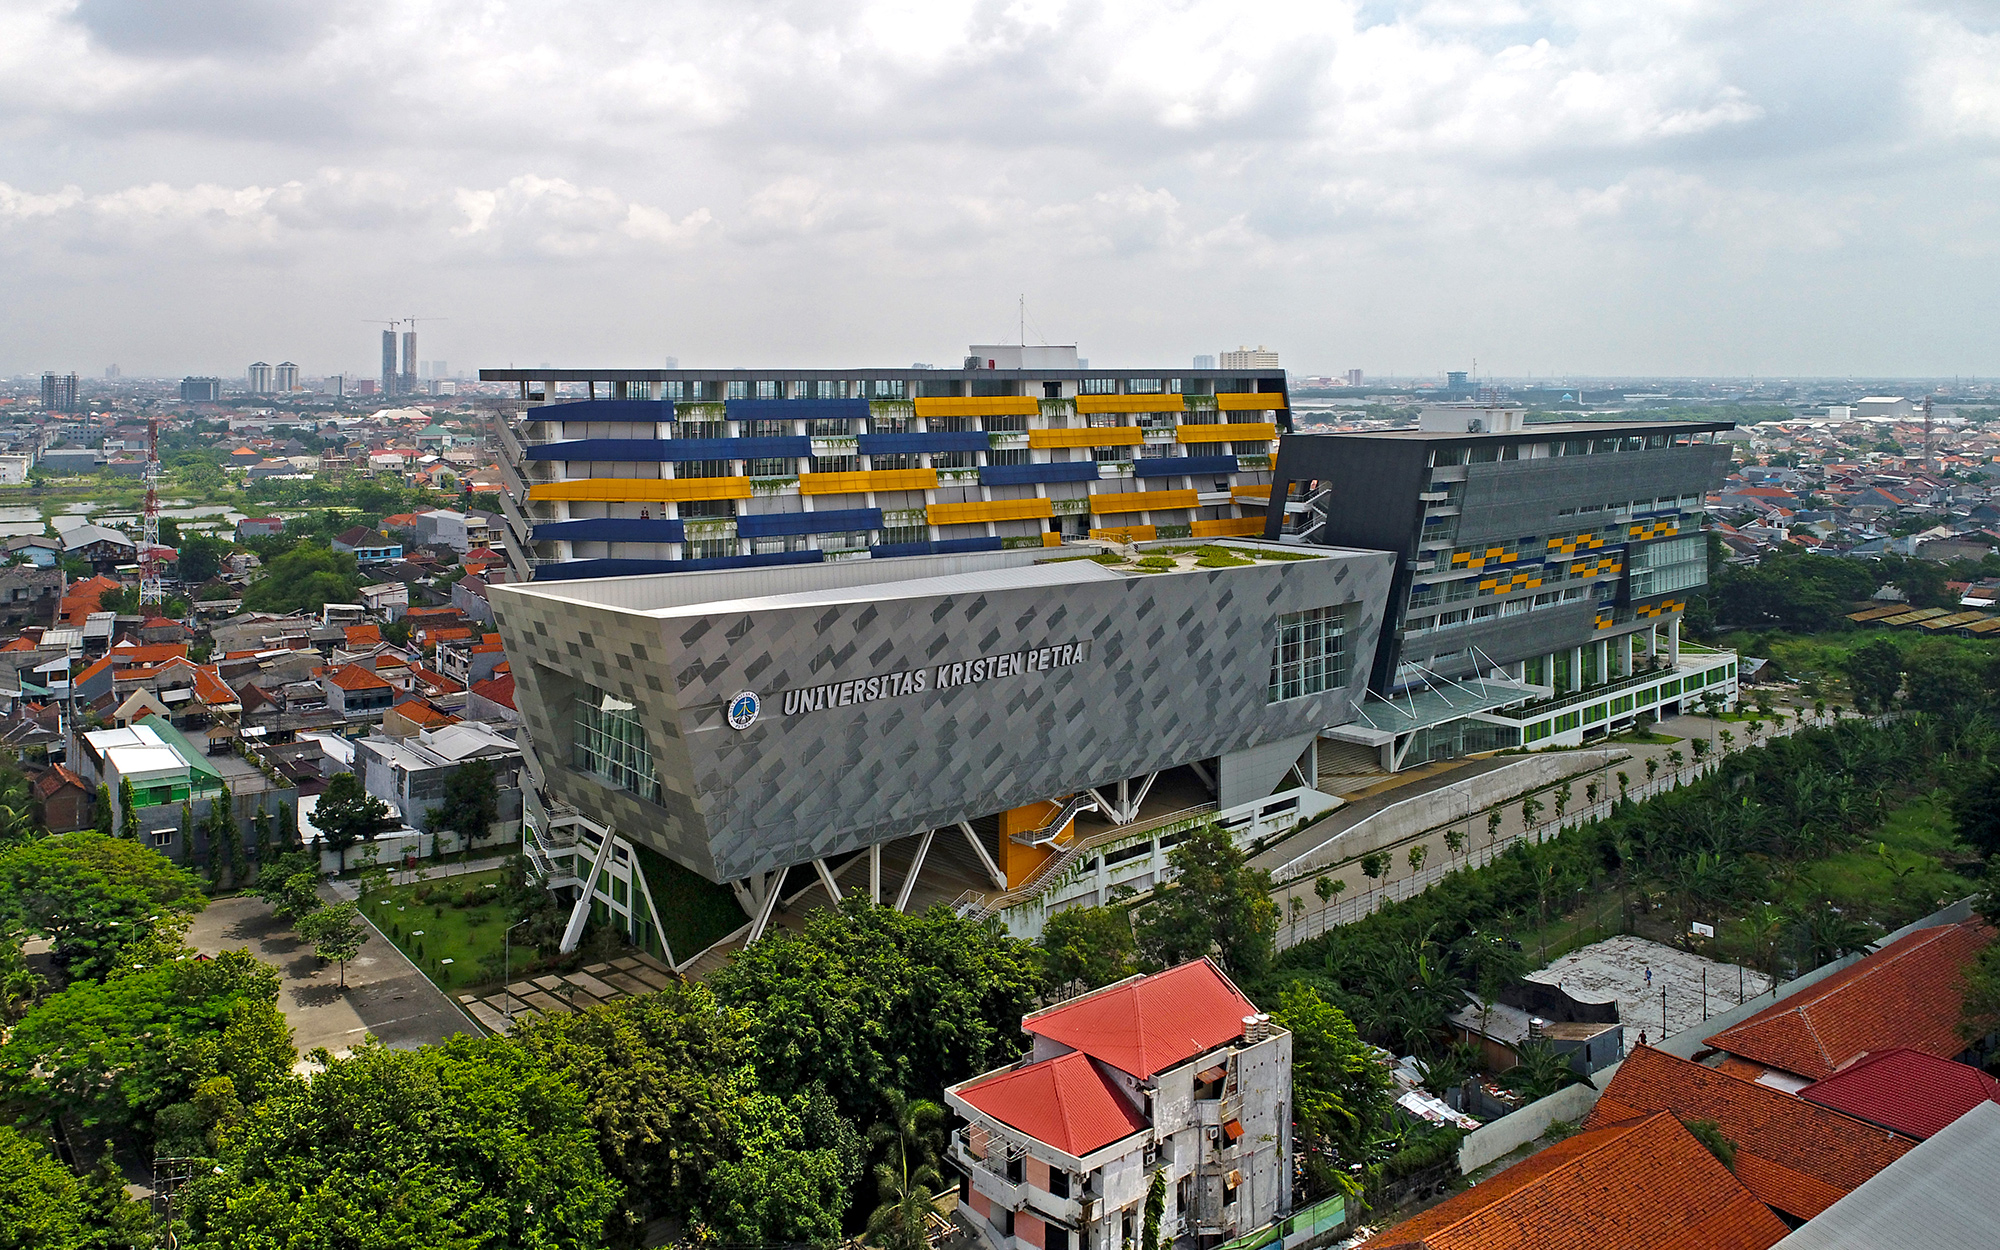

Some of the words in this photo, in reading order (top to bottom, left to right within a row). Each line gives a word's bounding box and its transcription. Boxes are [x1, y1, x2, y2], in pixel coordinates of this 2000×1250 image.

[784, 669, 927, 716] UNIVERSITAS
[936, 652, 1022, 689] KRISTEN
[1026, 643, 1083, 673] PETRA
